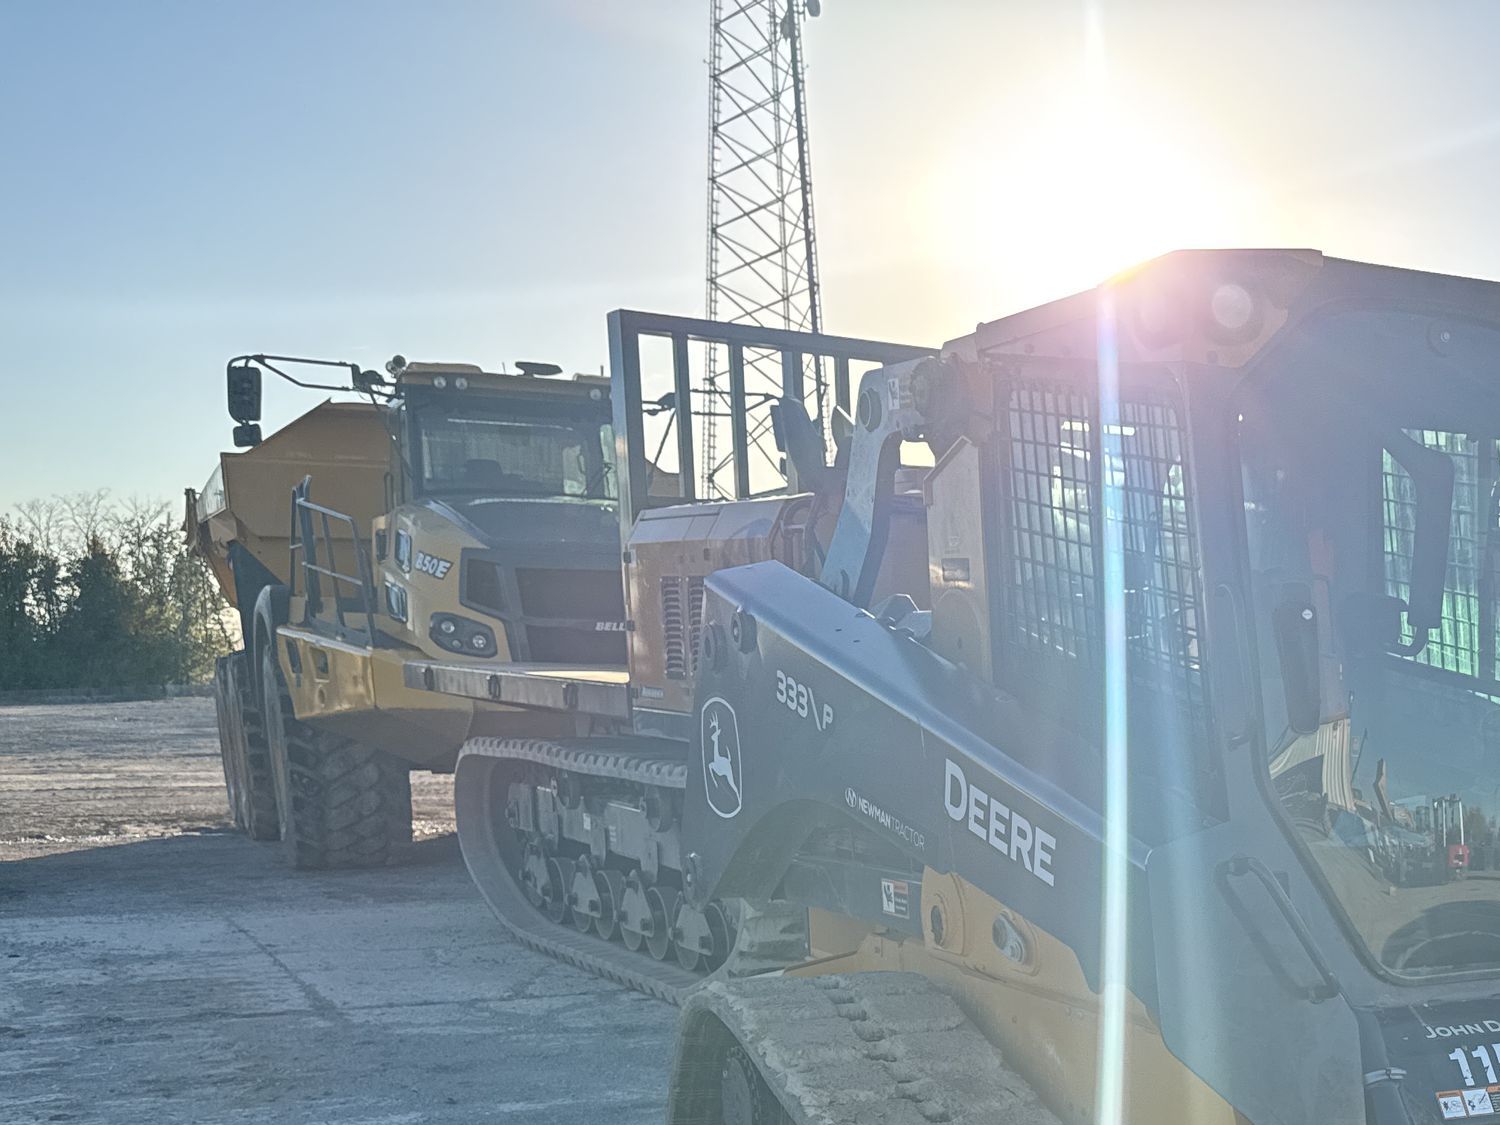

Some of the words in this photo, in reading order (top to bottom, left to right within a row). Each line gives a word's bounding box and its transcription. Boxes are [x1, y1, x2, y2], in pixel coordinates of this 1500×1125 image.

[415, 552, 451, 579] B50E
[595, 621, 626, 632] BELL
[944, 758, 1057, 887] DEERE
[1425, 1023, 1485, 1039] JOHN
